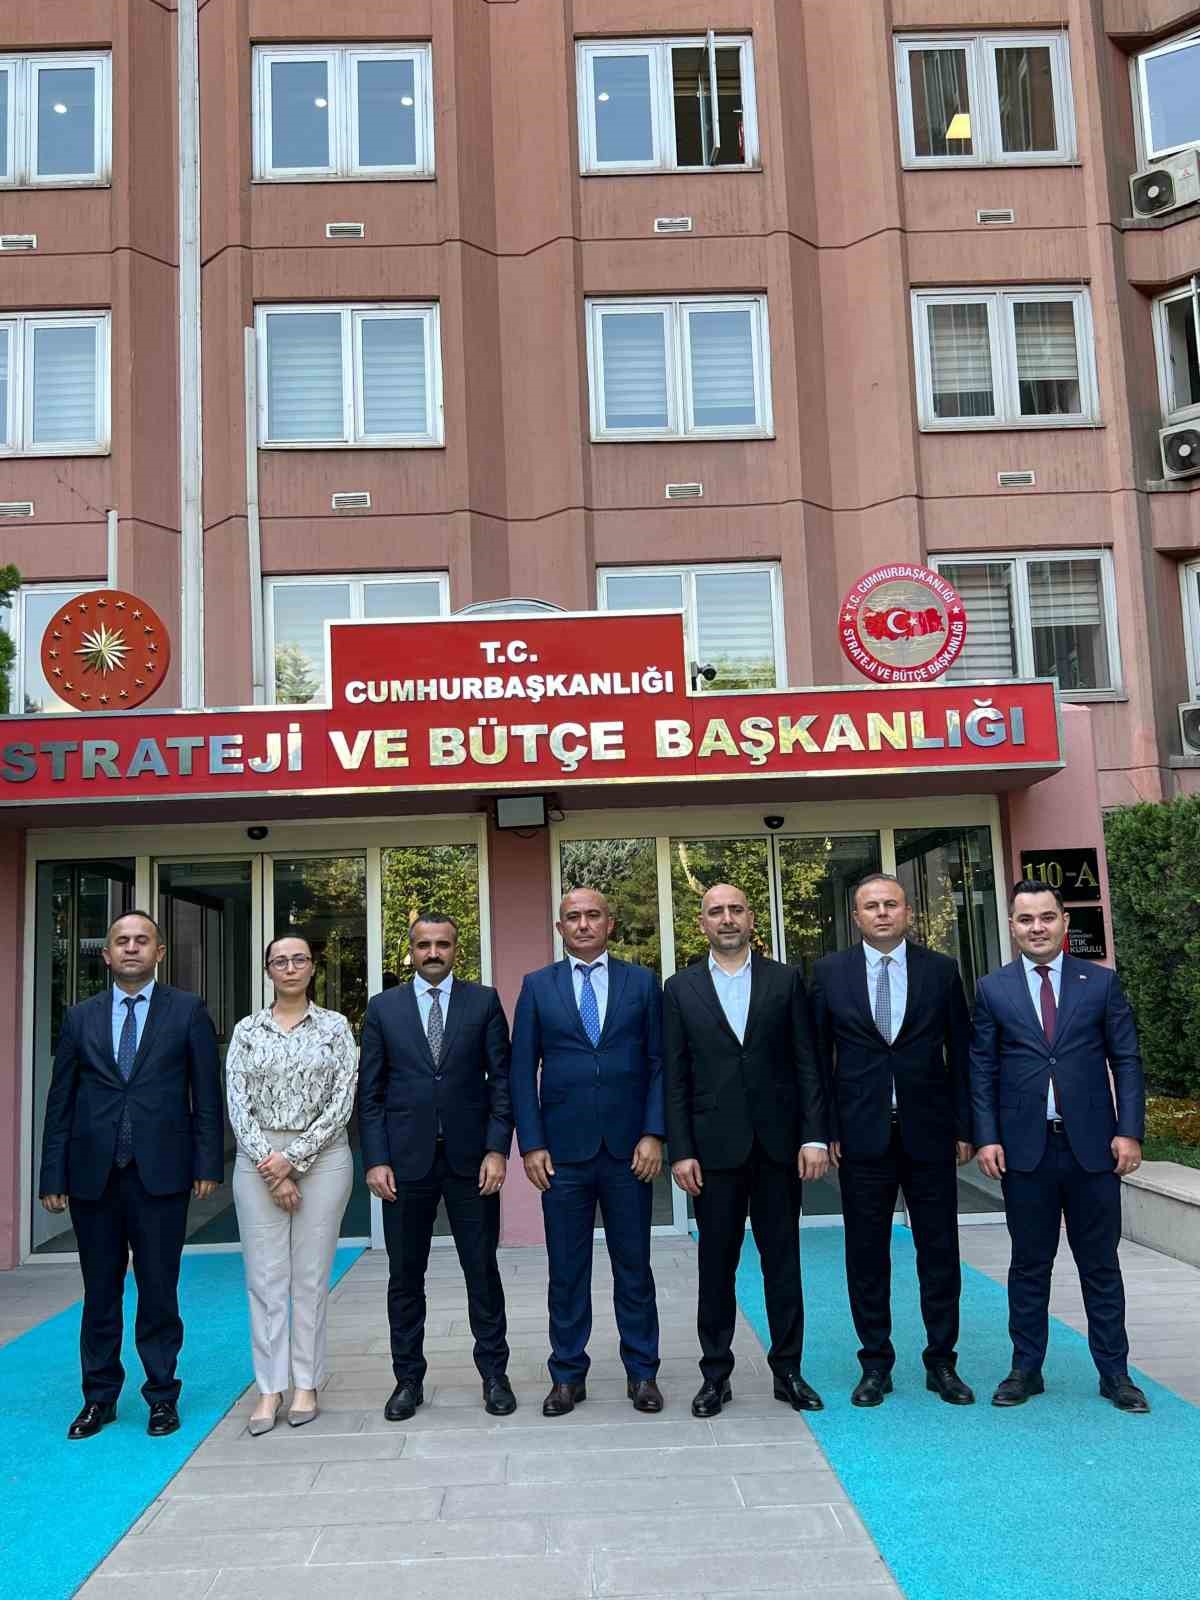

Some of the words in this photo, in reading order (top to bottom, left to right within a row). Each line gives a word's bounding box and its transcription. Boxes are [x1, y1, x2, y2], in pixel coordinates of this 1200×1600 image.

[857, 566, 955, 603] CUMHURBAŞKANLIĞI
[479, 640, 538, 664] T.C.
[843, 628, 877, 672] STRATEJİ
[876, 665, 890, 680] VE
[892, 669, 928, 682] BÜTÇE
[927, 621, 963, 674] BAŞKANLIĞI
[344, 666, 673, 703] CUMHURBAŞKANLIĞI
[2, 723, 303, 781] STRATEJİ
[328, 729, 408, 770] VE
[428, 717, 626, 771] BÜTÇE
[655, 699, 1026, 766] BAŞKANLIĞI
